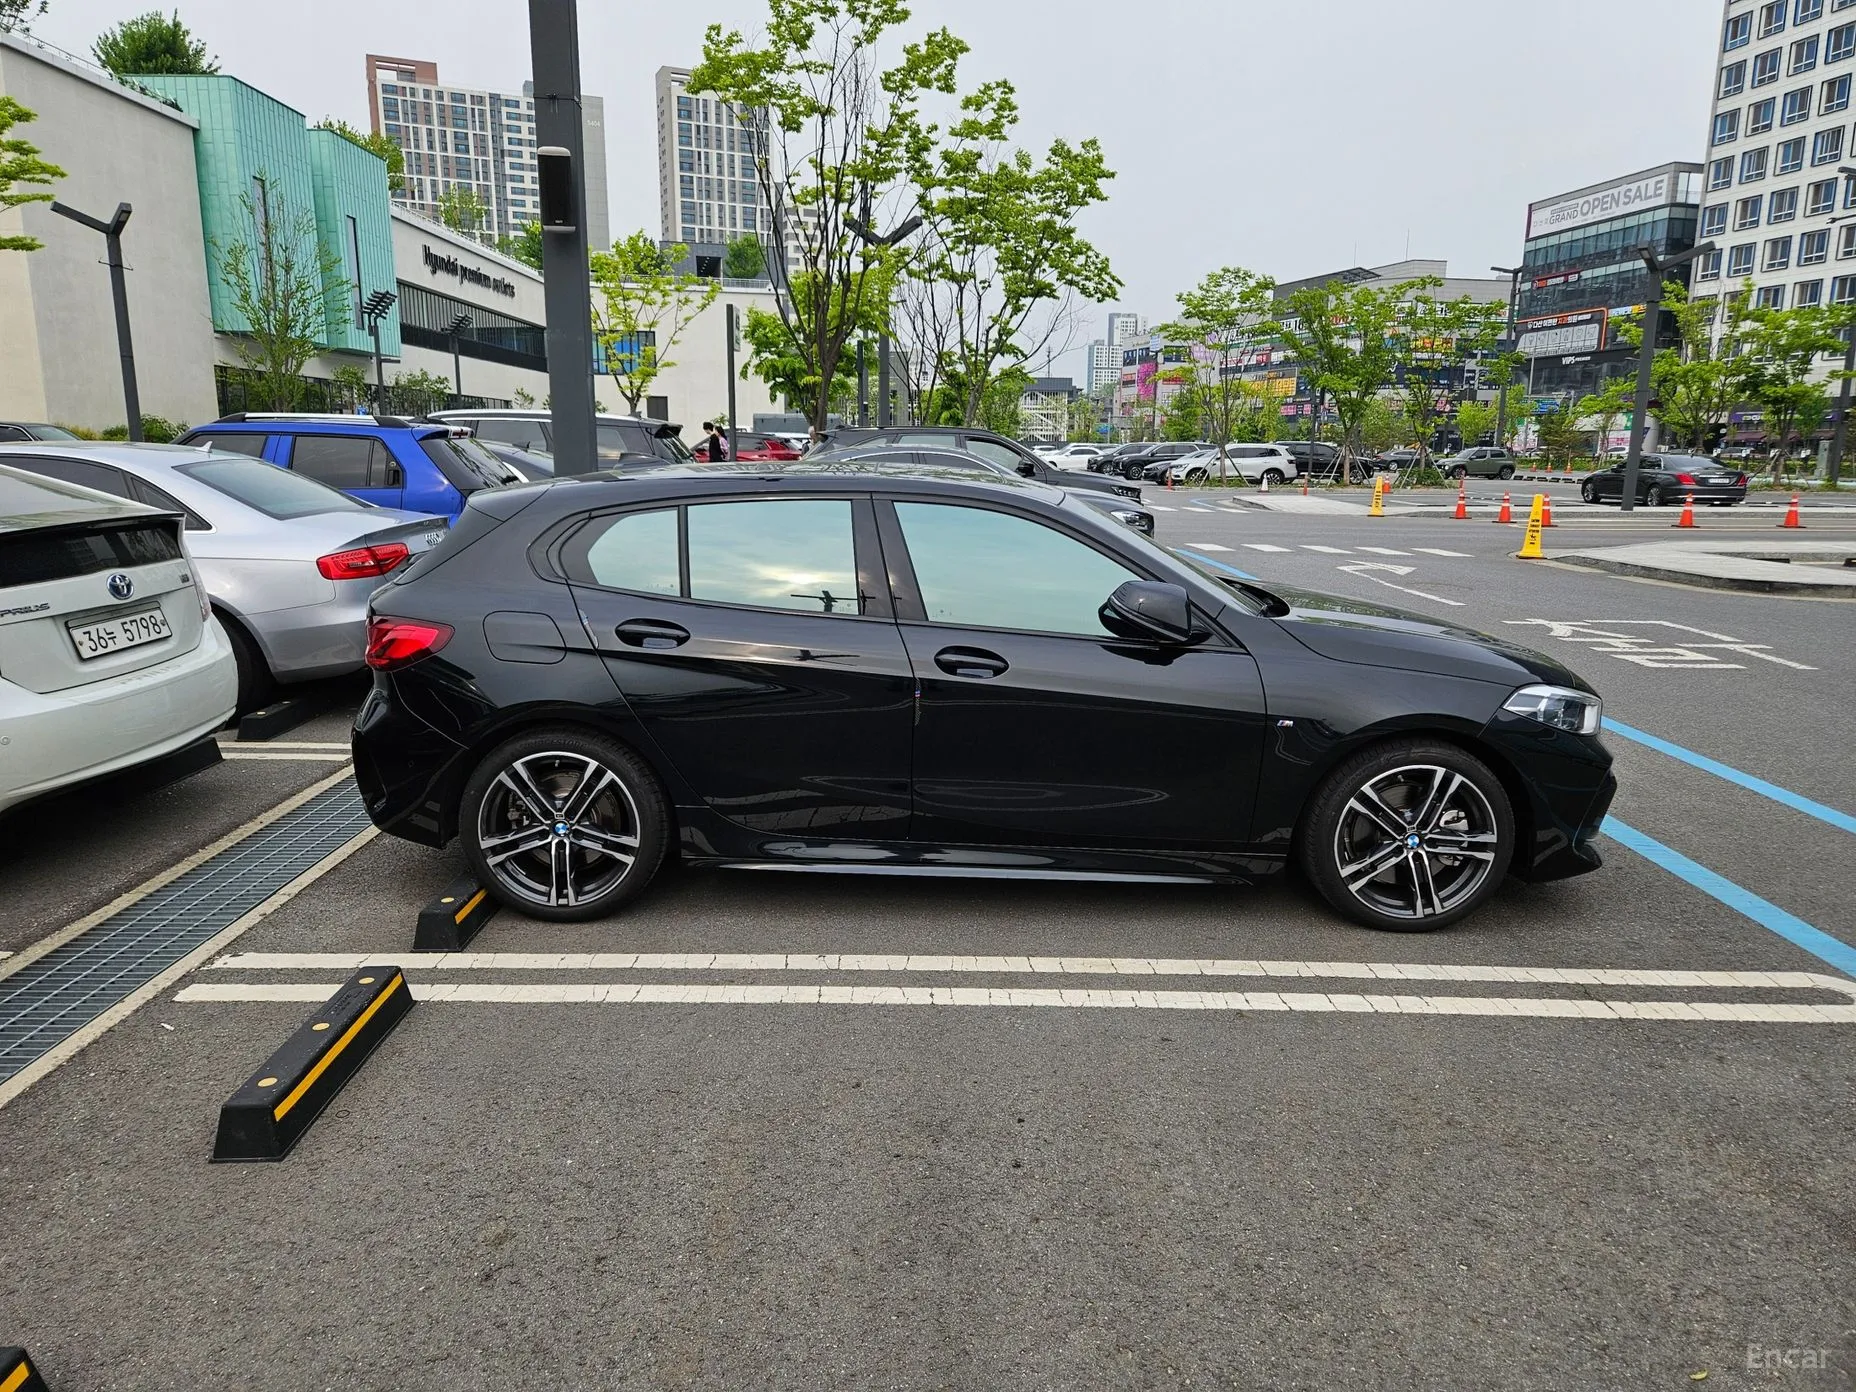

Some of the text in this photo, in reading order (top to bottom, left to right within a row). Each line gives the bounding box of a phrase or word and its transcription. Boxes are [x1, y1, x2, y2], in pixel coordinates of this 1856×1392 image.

[1549, 209, 1579, 225] GRAND
[1580, 191, 1621, 216] OPEN
[1623, 179, 1664, 206] SALE
[422, 244, 516, 298] Hyundai premium outlets
[1561, 355, 1575, 365] VIPS
[82, 614, 162, 652] 36누 5798
